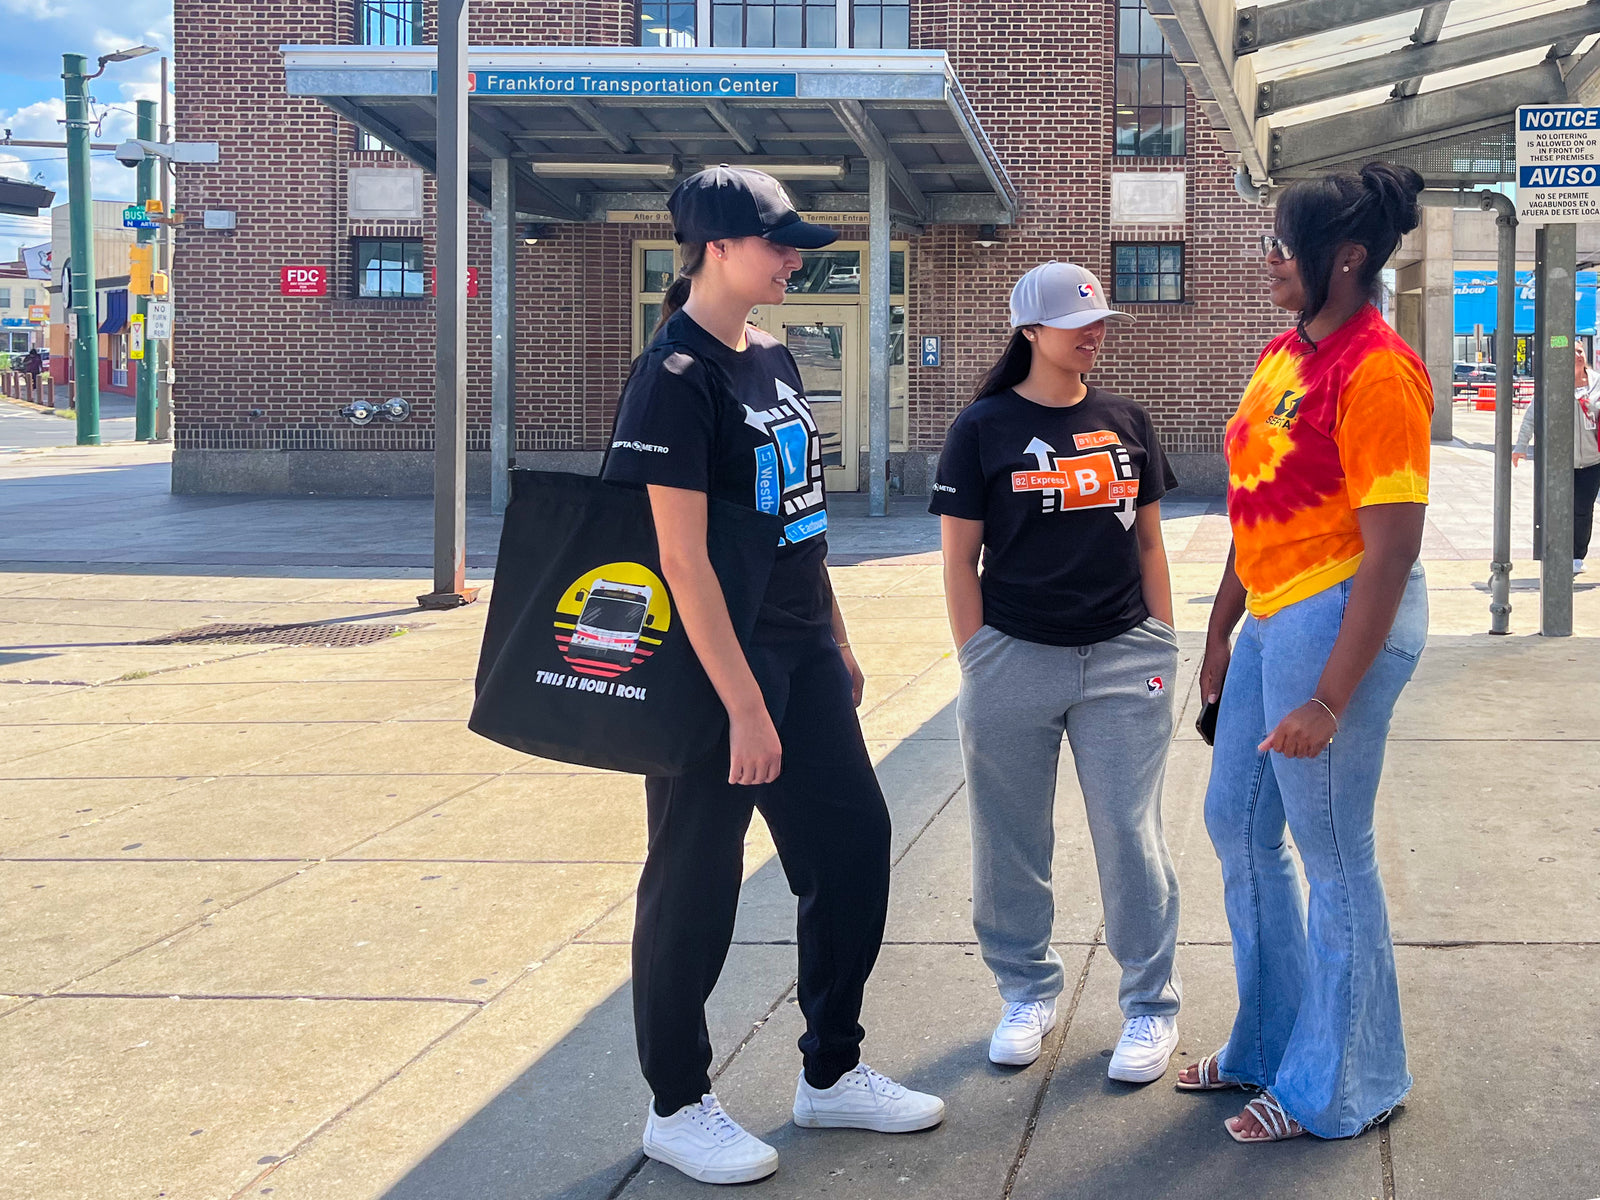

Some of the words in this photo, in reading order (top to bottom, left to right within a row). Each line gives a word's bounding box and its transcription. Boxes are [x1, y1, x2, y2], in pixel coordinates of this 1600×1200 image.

[487, 75, 574, 91] Frankford
[581, 76, 712, 95] Transportation
[718, 77, 779, 93] Center
[1525, 110, 1598, 128] NOTICE
[1549, 132, 1588, 140] LOITERING
[1555, 153, 1594, 161] PREMISES
[1528, 166, 1597, 186] AVISO
[1529, 200, 1577, 208] VAGABUNDOS
[634, 213, 653, 221] After
[287, 269, 320, 282] FDC
[1453, 285, 1486, 295] nbow
[642, 443, 670, 454] METRO
[761, 451, 772, 462] L1
[1015, 476, 1027, 487] B2
[1030, 475, 1066, 486] Express
[1074, 468, 1101, 497] B
[1112, 485, 1125, 494] B3
[535, 670, 566, 686] THIS
[565, 675, 579, 689] IS
[577, 677, 608, 694] HOW
[608, 682, 615, 696] I
[615, 683, 647, 701] ROLL
